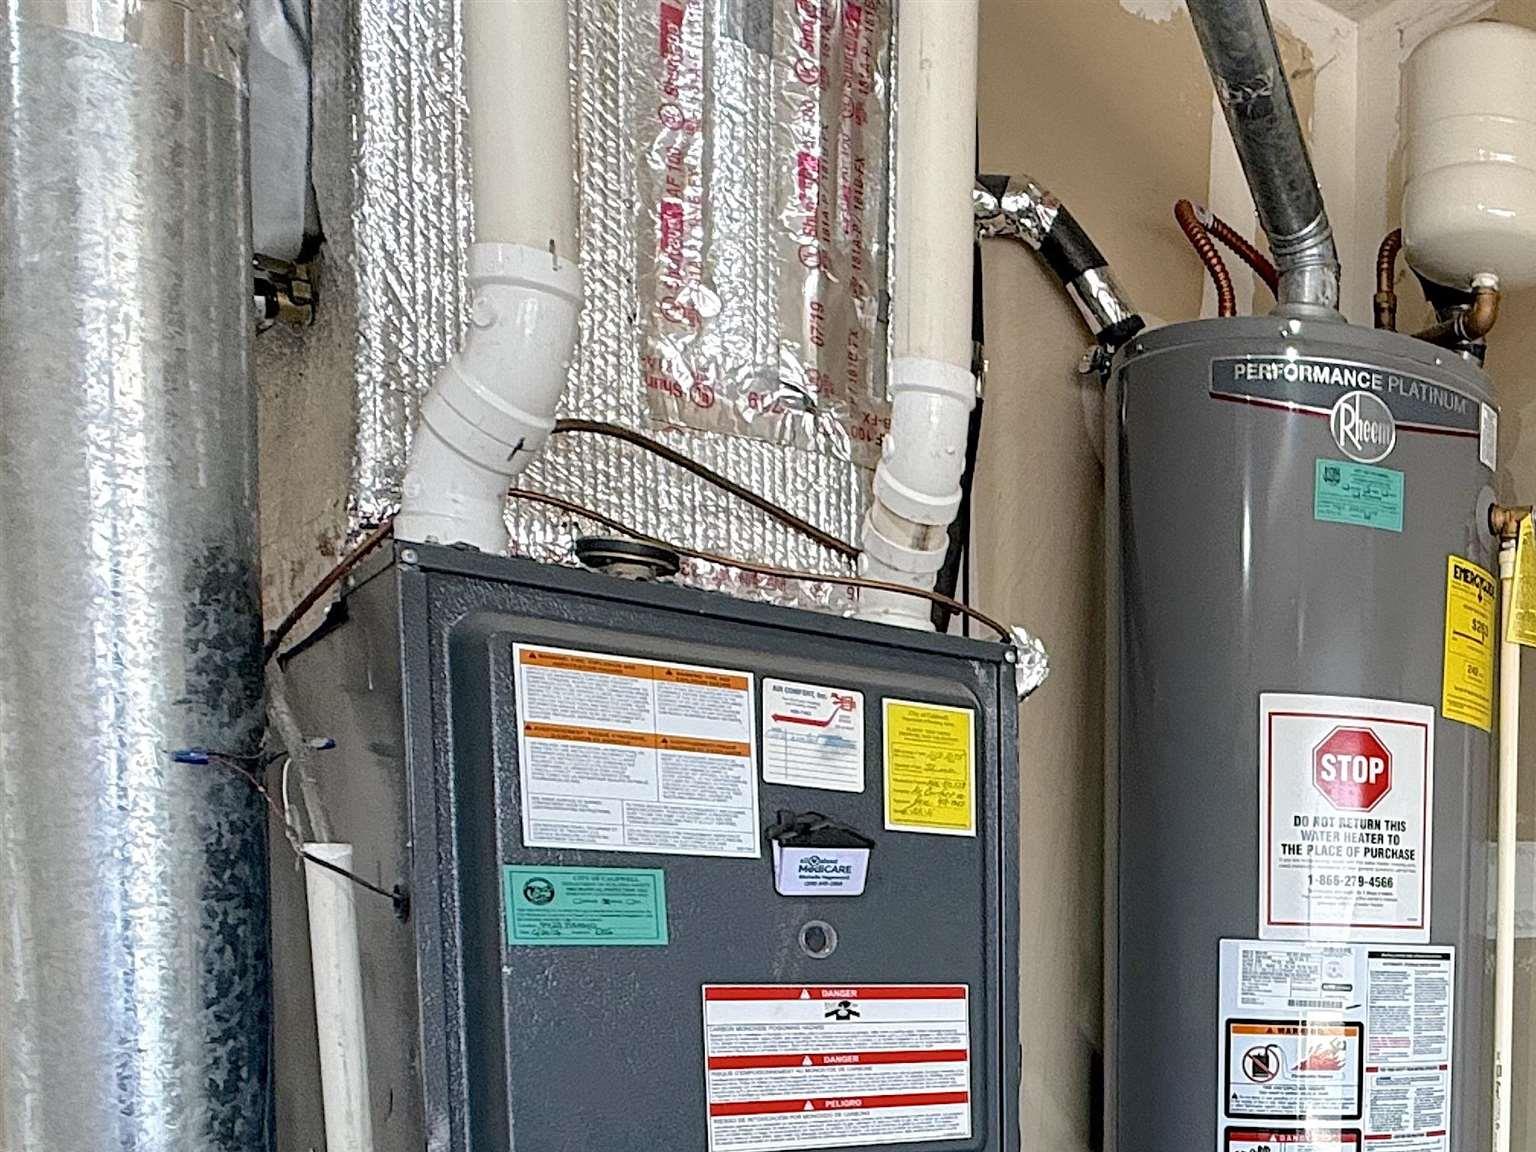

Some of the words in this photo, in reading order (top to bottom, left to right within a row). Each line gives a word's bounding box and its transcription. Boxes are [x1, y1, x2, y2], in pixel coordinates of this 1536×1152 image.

[810, 301, 825, 348] 07/19
[1233, 361, 1384, 392] PERFORMANCE
[1387, 375, 1467, 416] PLATINUM
[1339, 394, 1392, 451] Rheem
[1320, 752, 1385, 785] STOP
[1293, 815, 1310, 828] DO
[1312, 815, 1335, 829] NOT
[1338, 817, 1382, 831] RETURN
[1384, 819, 1407, 833] THIS
[1300, 829, 1340, 843] WATER
[1343, 831, 1384, 846] HEATER
[1387, 833, 1401, 847] TO
[1280, 843, 1303, 856] THE
[1306, 843, 1343, 858] PLACE
[1345, 846, 1361, 859] OF
[1363, 846, 1416, 861] PURCHASE
[1307, 874, 1394, 889] 1-866-279-4566
[821, 989, 858, 998] DANGER
[823, 1054, 860, 1064] DANGER
[824, 1098, 862, 1108] PELIGRO
